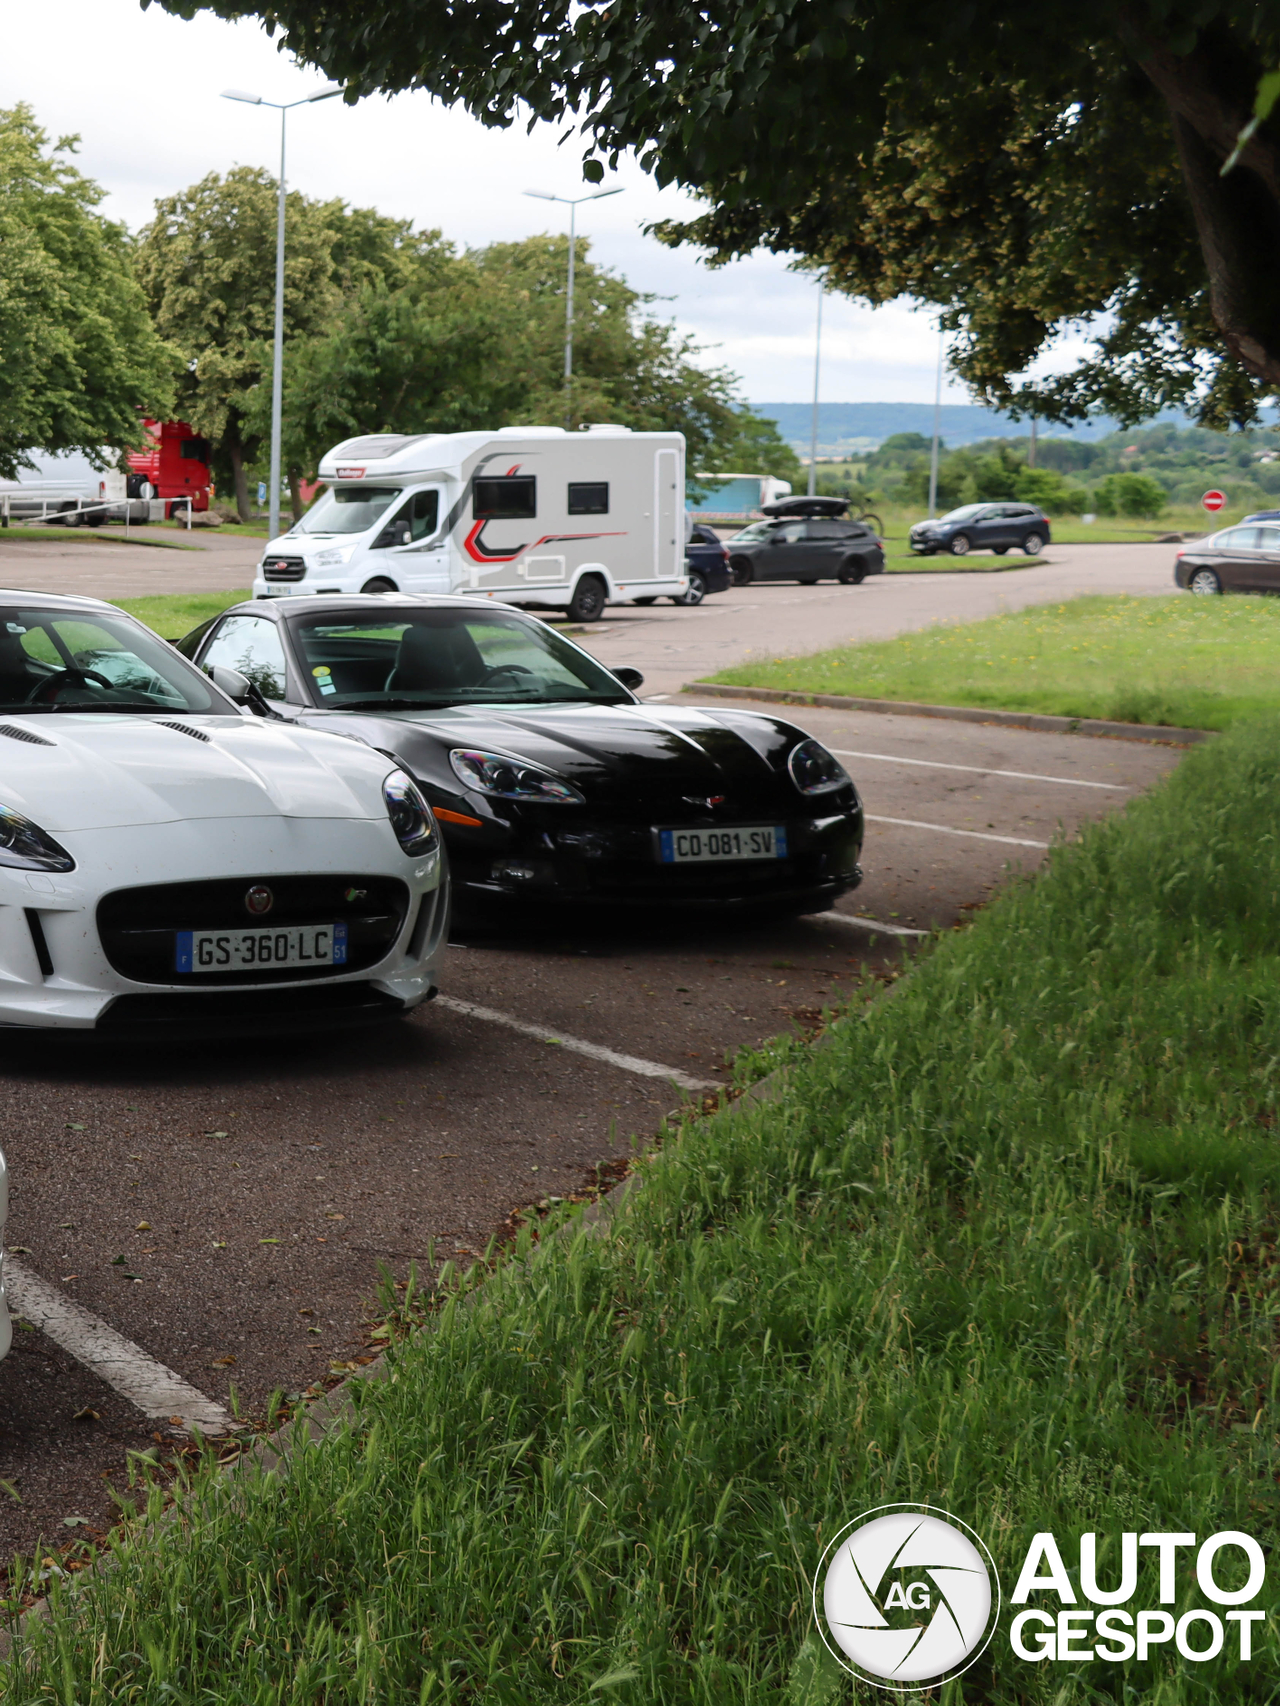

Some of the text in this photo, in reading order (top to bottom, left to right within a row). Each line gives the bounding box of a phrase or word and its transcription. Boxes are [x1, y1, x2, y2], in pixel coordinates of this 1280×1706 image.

[677, 832, 772, 857] CD-081-SV
[198, 932, 329, 965] GS-360-LC
[334, 945, 346, 958] 51
